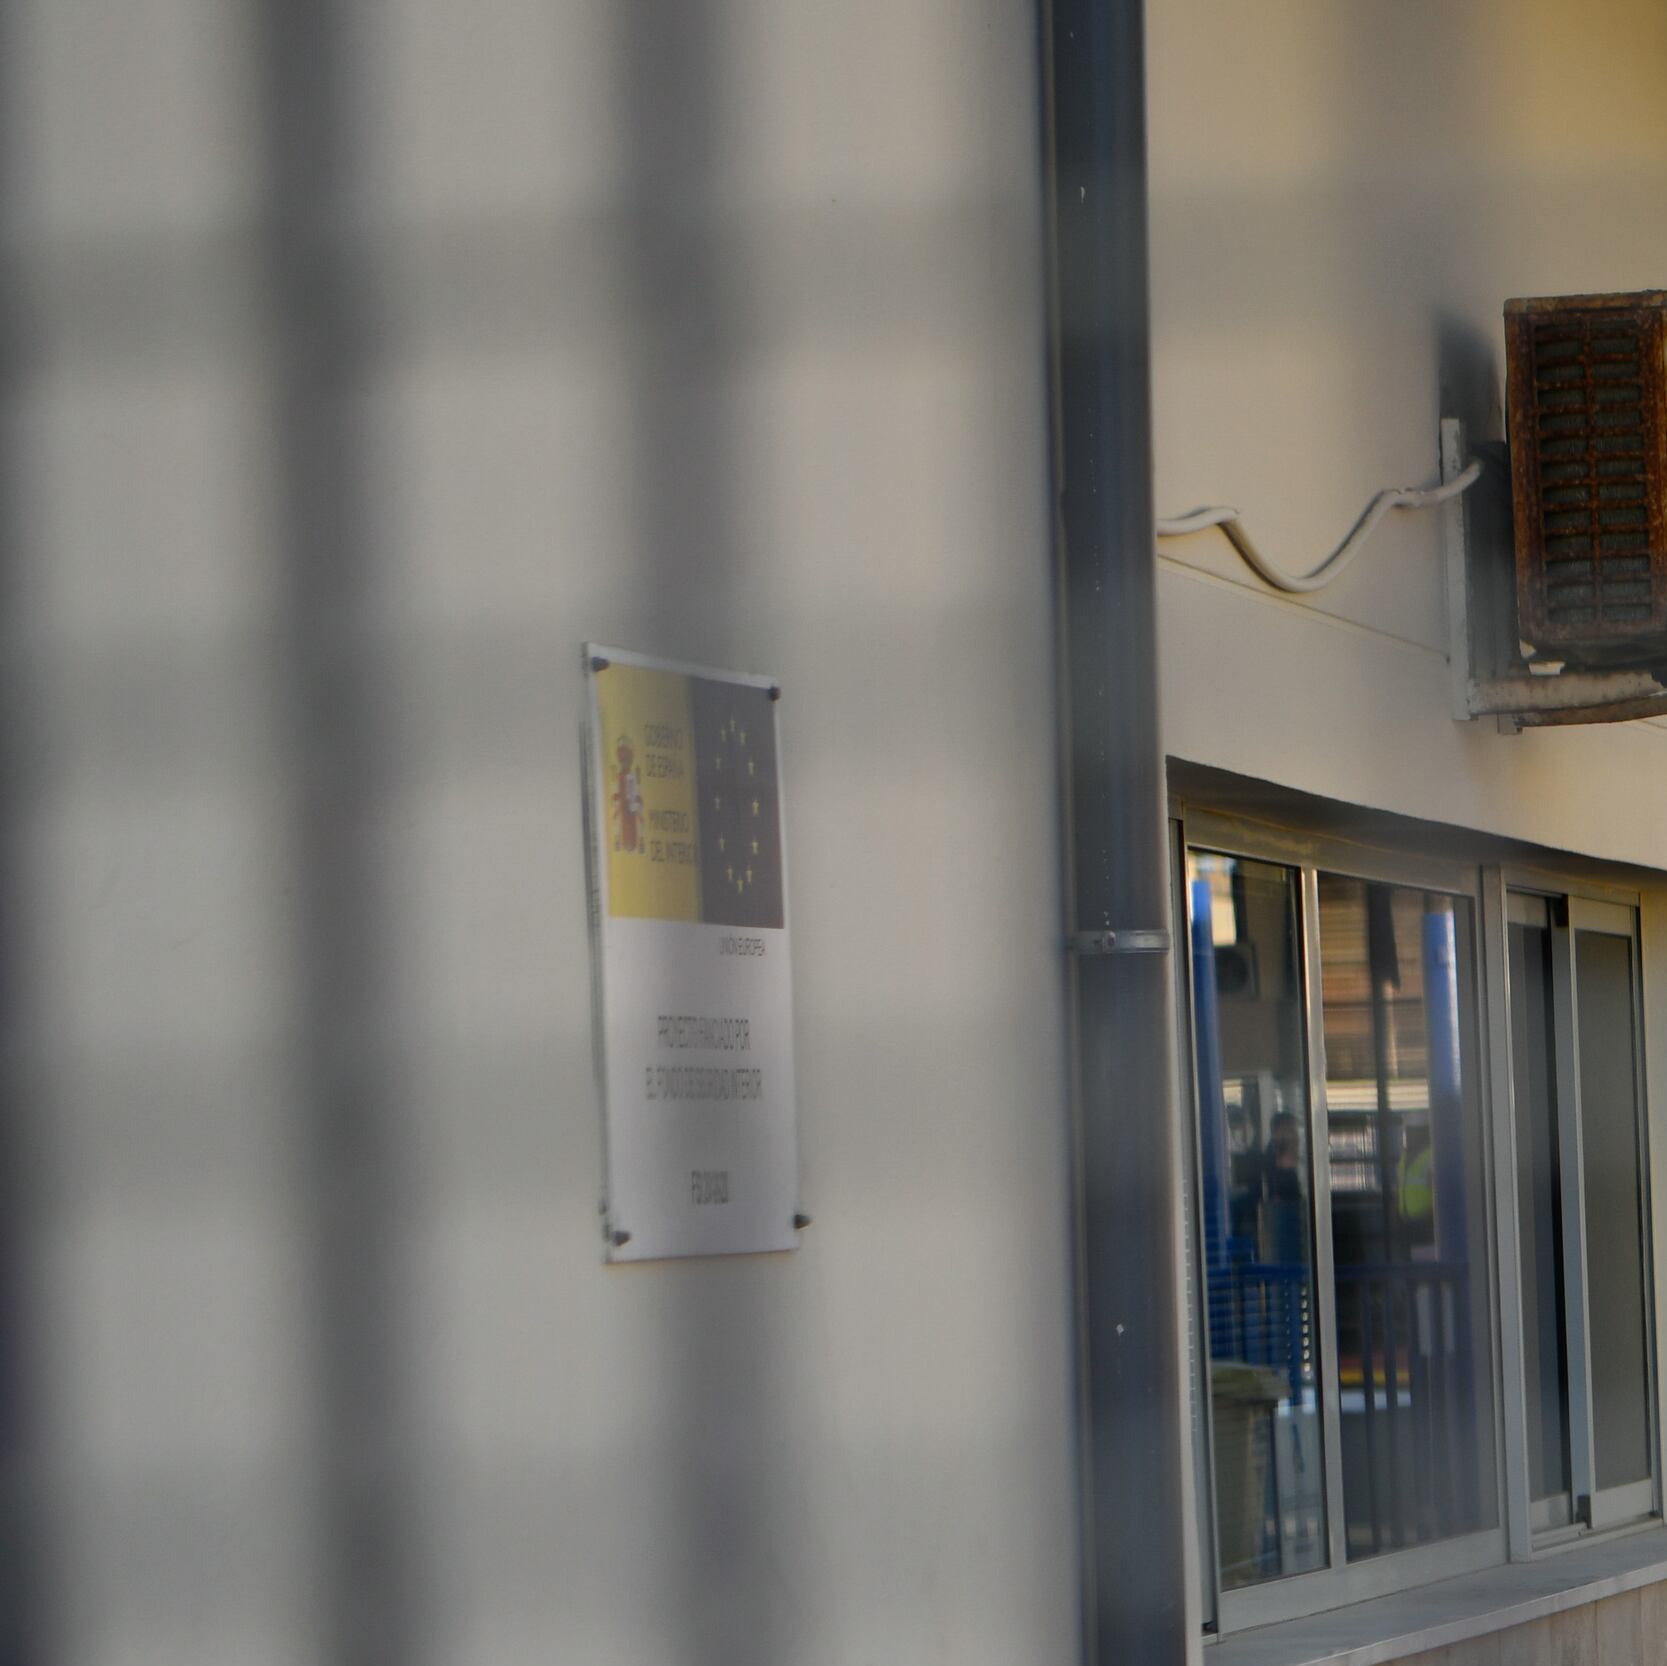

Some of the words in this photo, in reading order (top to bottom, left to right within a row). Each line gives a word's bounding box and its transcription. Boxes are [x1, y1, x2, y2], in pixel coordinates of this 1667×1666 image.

[645, 753, 656, 776] DE
[650, 839, 665, 862] DEL
[736, 1017, 751, 1051] POR
